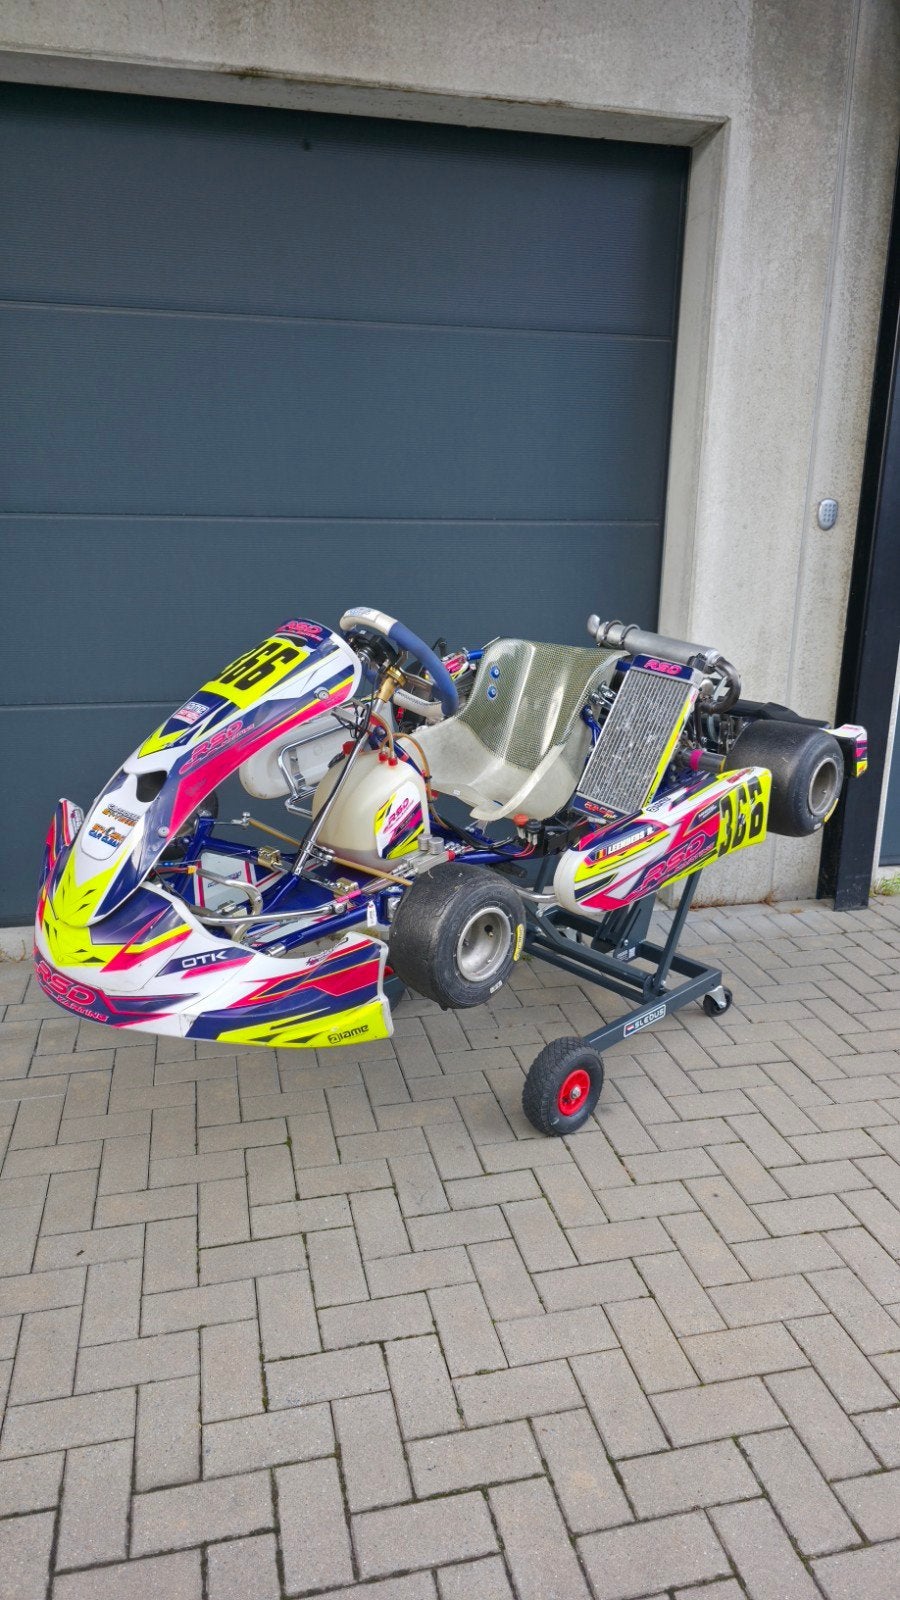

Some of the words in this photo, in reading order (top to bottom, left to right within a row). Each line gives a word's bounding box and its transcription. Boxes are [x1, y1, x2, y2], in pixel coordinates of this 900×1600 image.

[188, 720, 244, 763] RSD
[638, 834, 706, 891] RSD
[182, 950, 228, 969] OTK
[36, 960, 97, 1006] RSD
